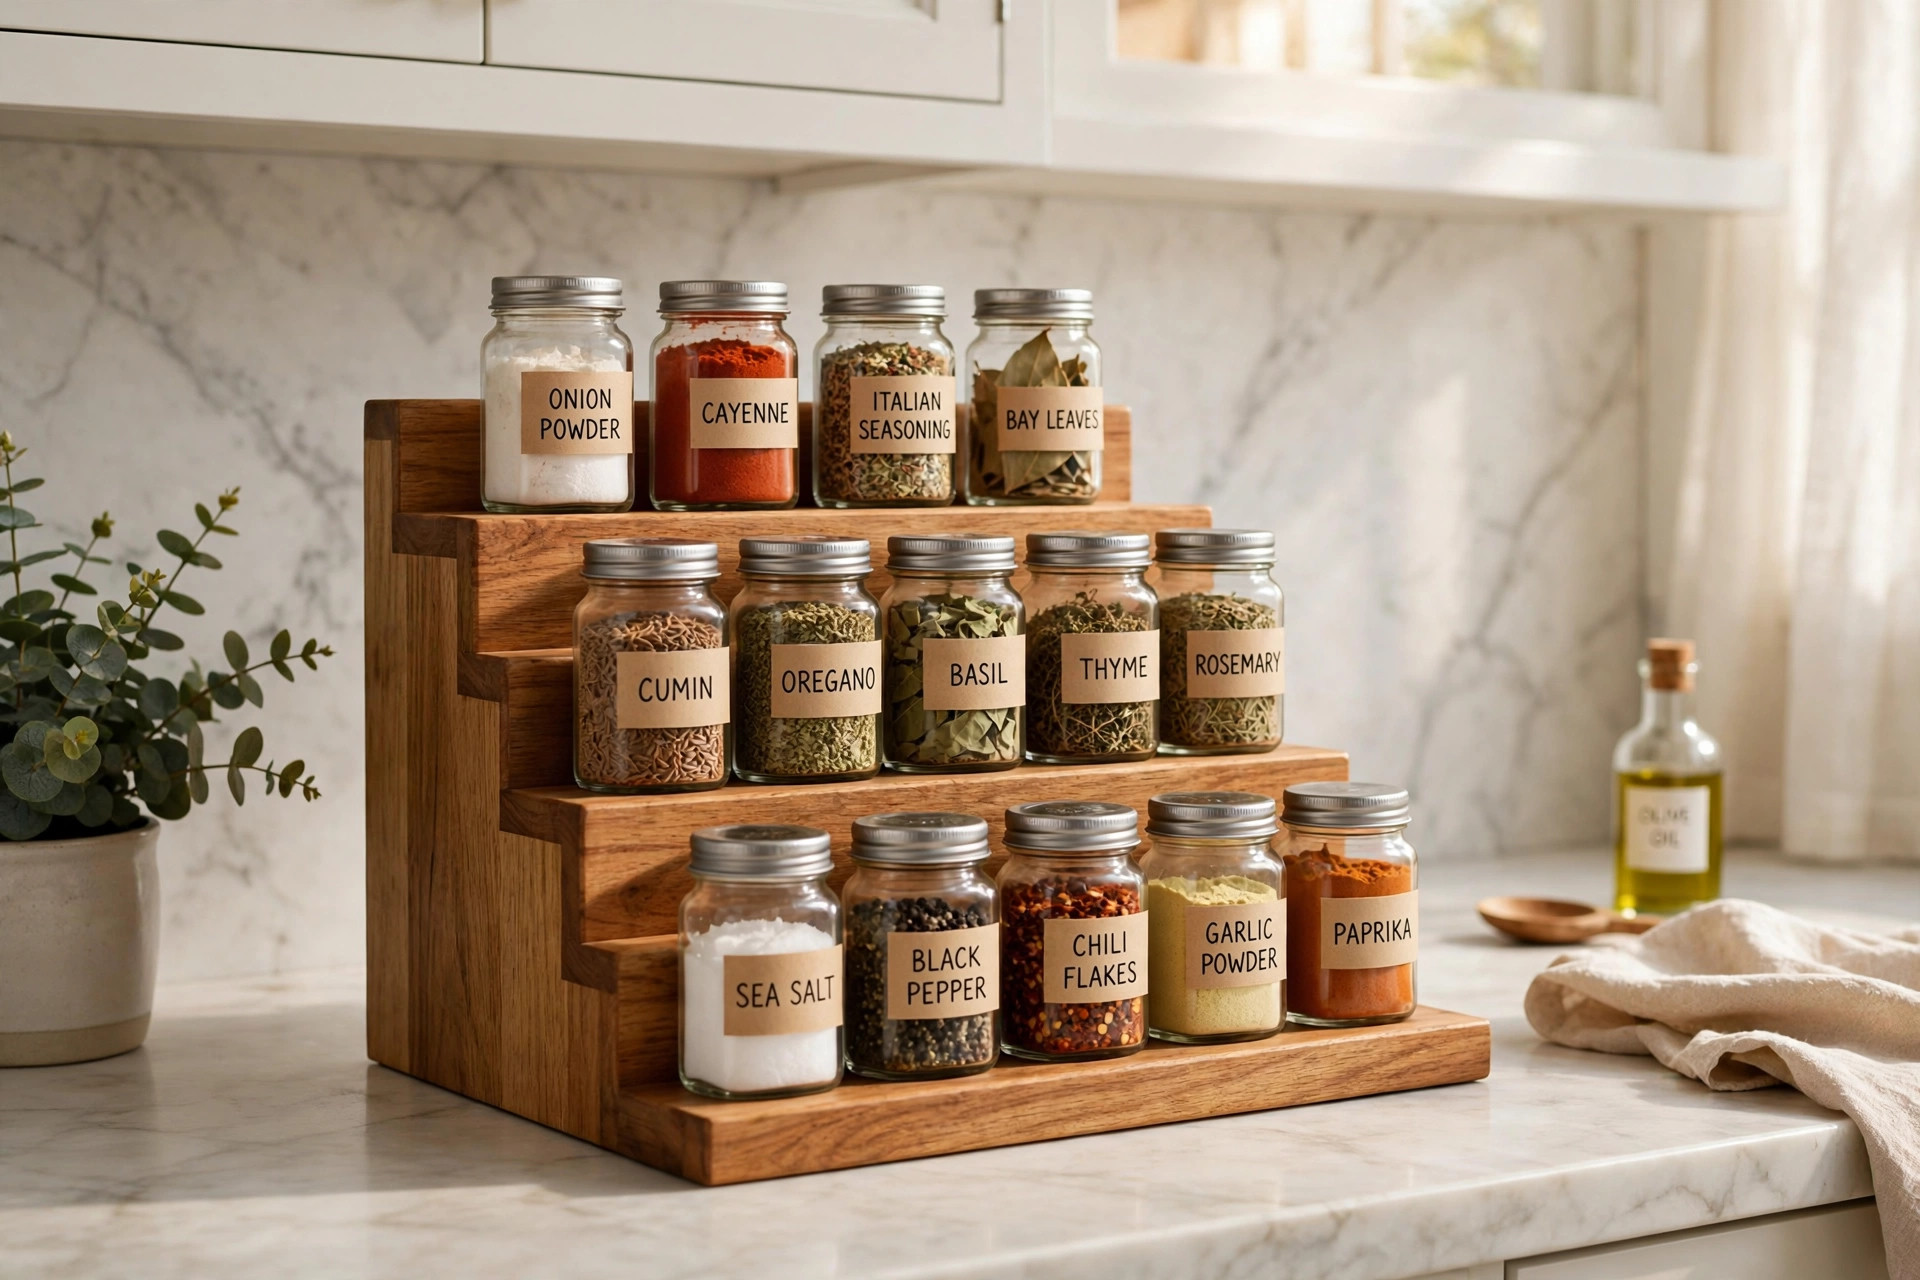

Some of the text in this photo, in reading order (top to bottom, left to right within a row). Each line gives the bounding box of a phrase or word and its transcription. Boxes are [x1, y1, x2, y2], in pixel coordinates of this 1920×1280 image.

[549, 388, 612, 410] ONION
[873, 391, 941, 412] ITALIAN
[702, 402, 789, 424] CAYENNE
[1006, 409, 1099, 430] BAY LEAVES
[540, 418, 621, 440] POWDER
[859, 419, 951, 440] SEASONING
[950, 662, 1009, 687] BASIL
[1079, 655, 1149, 681] THYME
[1195, 651, 1281, 676] ROSEMARY
[638, 675, 713, 703] CUMIN
[781, 666, 876, 693] OREGANO
[1073, 930, 1127, 957] CHILI
[1205, 917, 1273, 946] GARLIC
[1333, 917, 1412, 946] PAPRIKA
[912, 945, 981, 973] BLACK
[1201, 947, 1278, 976] POWDER
[1063, 960, 1137, 990] FLAKES
[736, 975, 835, 1008] SEA SALT
[907, 976, 987, 1006] PEPPER
